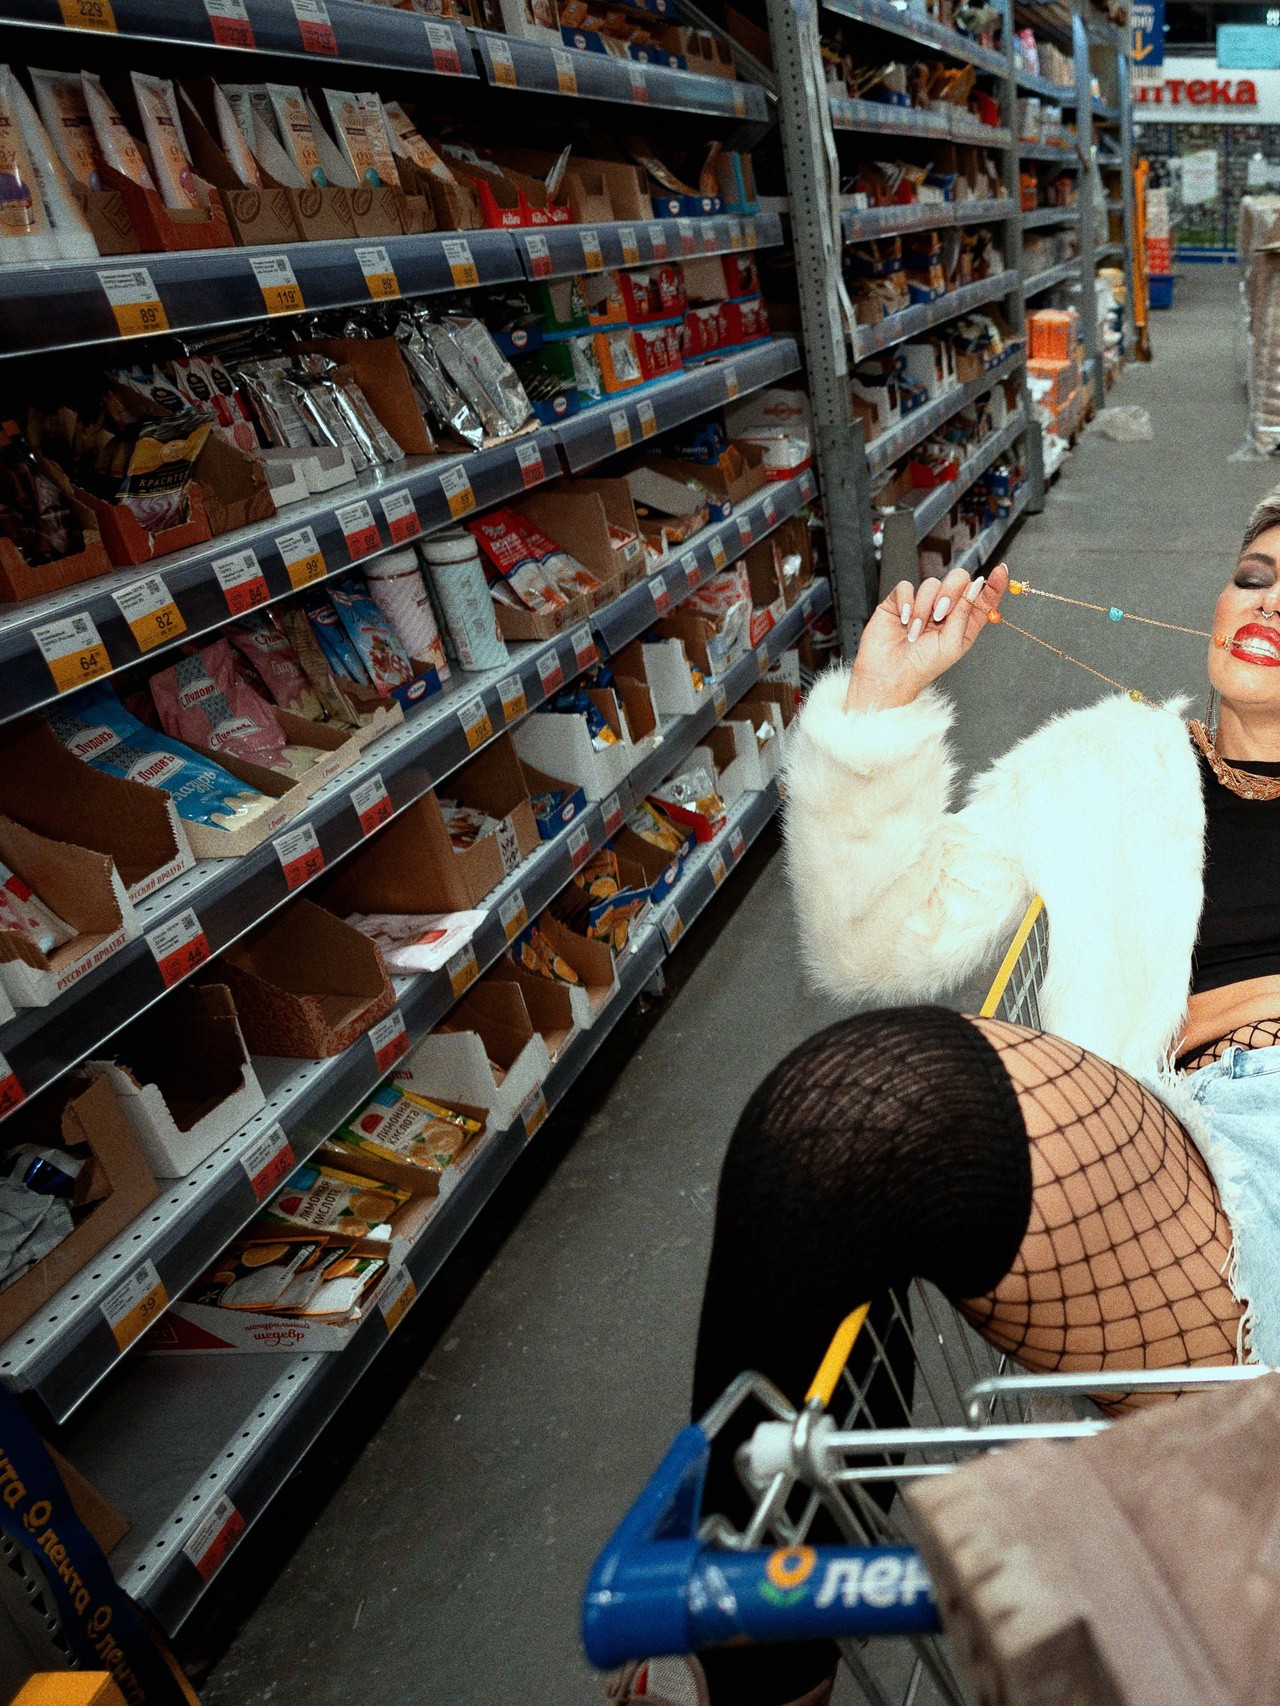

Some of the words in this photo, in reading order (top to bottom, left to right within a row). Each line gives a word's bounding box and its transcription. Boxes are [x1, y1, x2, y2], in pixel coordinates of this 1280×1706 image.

[156, 612, 173, 629] 82
[79, 653, 99, 671] 64
[253, 1328, 305, 1348] шедевр
[37, 1531, 91, 1617] лента
